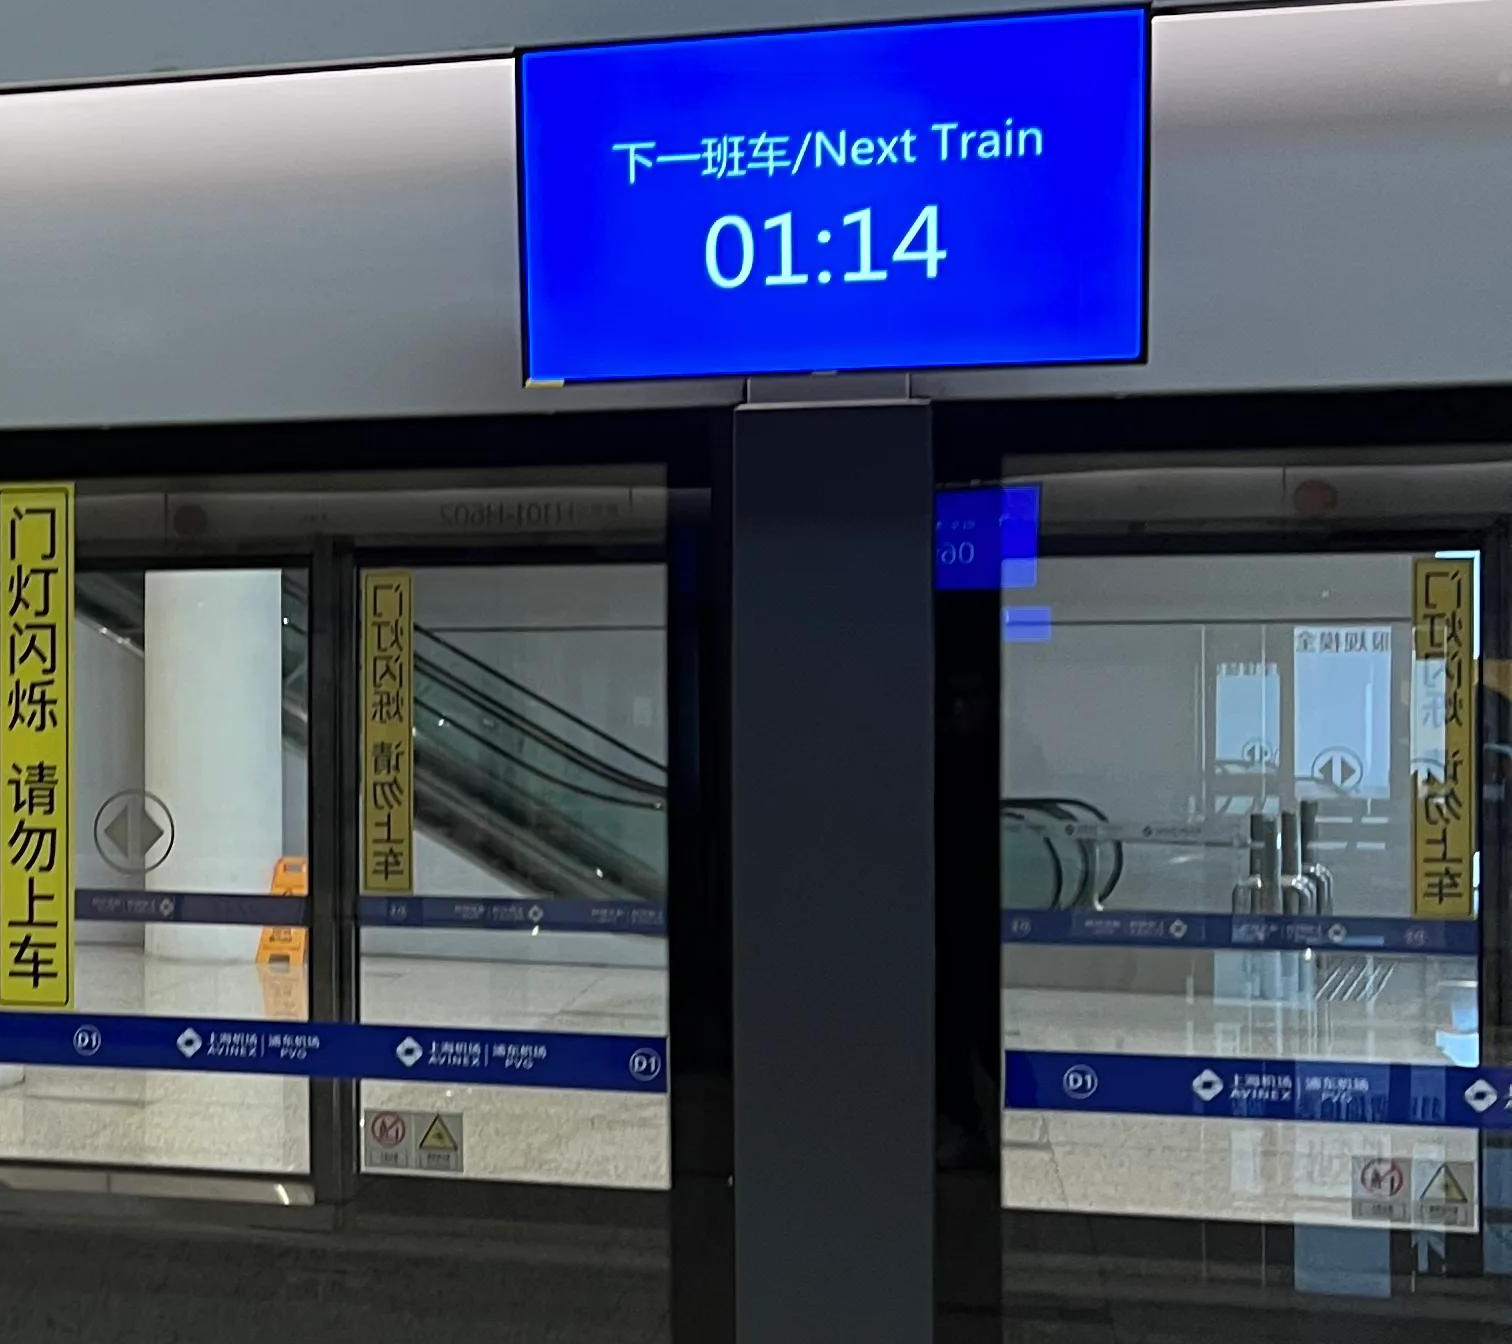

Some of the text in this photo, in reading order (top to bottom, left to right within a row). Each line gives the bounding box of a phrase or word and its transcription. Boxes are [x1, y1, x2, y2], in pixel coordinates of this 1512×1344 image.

[931, 117, 1044, 161] Train
[704, 204, 948, 290] 01:14
[7, 506, 59, 989] 门灯闪烁 请勿上车
[76, 1031, 98, 1049] D1
[633, 1057, 657, 1074] D1
[1068, 1073, 1093, 1090] D1
